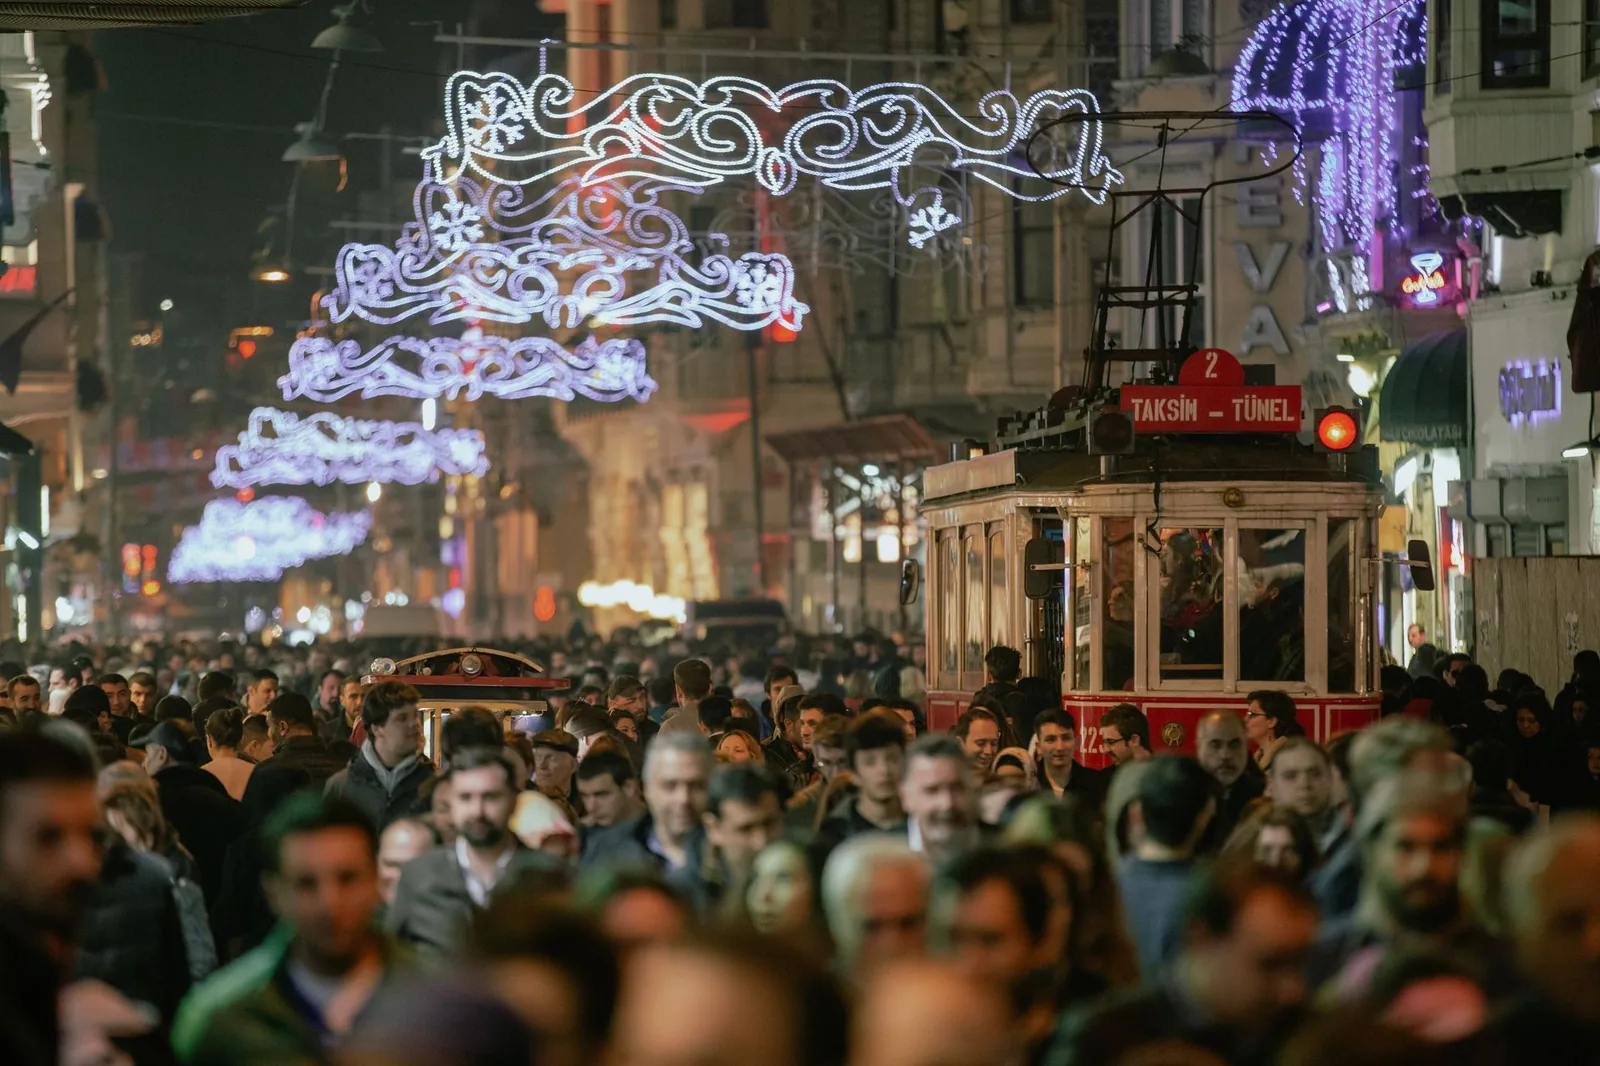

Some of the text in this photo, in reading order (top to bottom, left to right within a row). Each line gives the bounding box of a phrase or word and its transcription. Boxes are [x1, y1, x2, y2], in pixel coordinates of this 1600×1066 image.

[1205, 352, 1218, 379] 2
[1131, 394, 1198, 422] TAKSİM
[1232, 394, 1295, 422] TÜNEL
